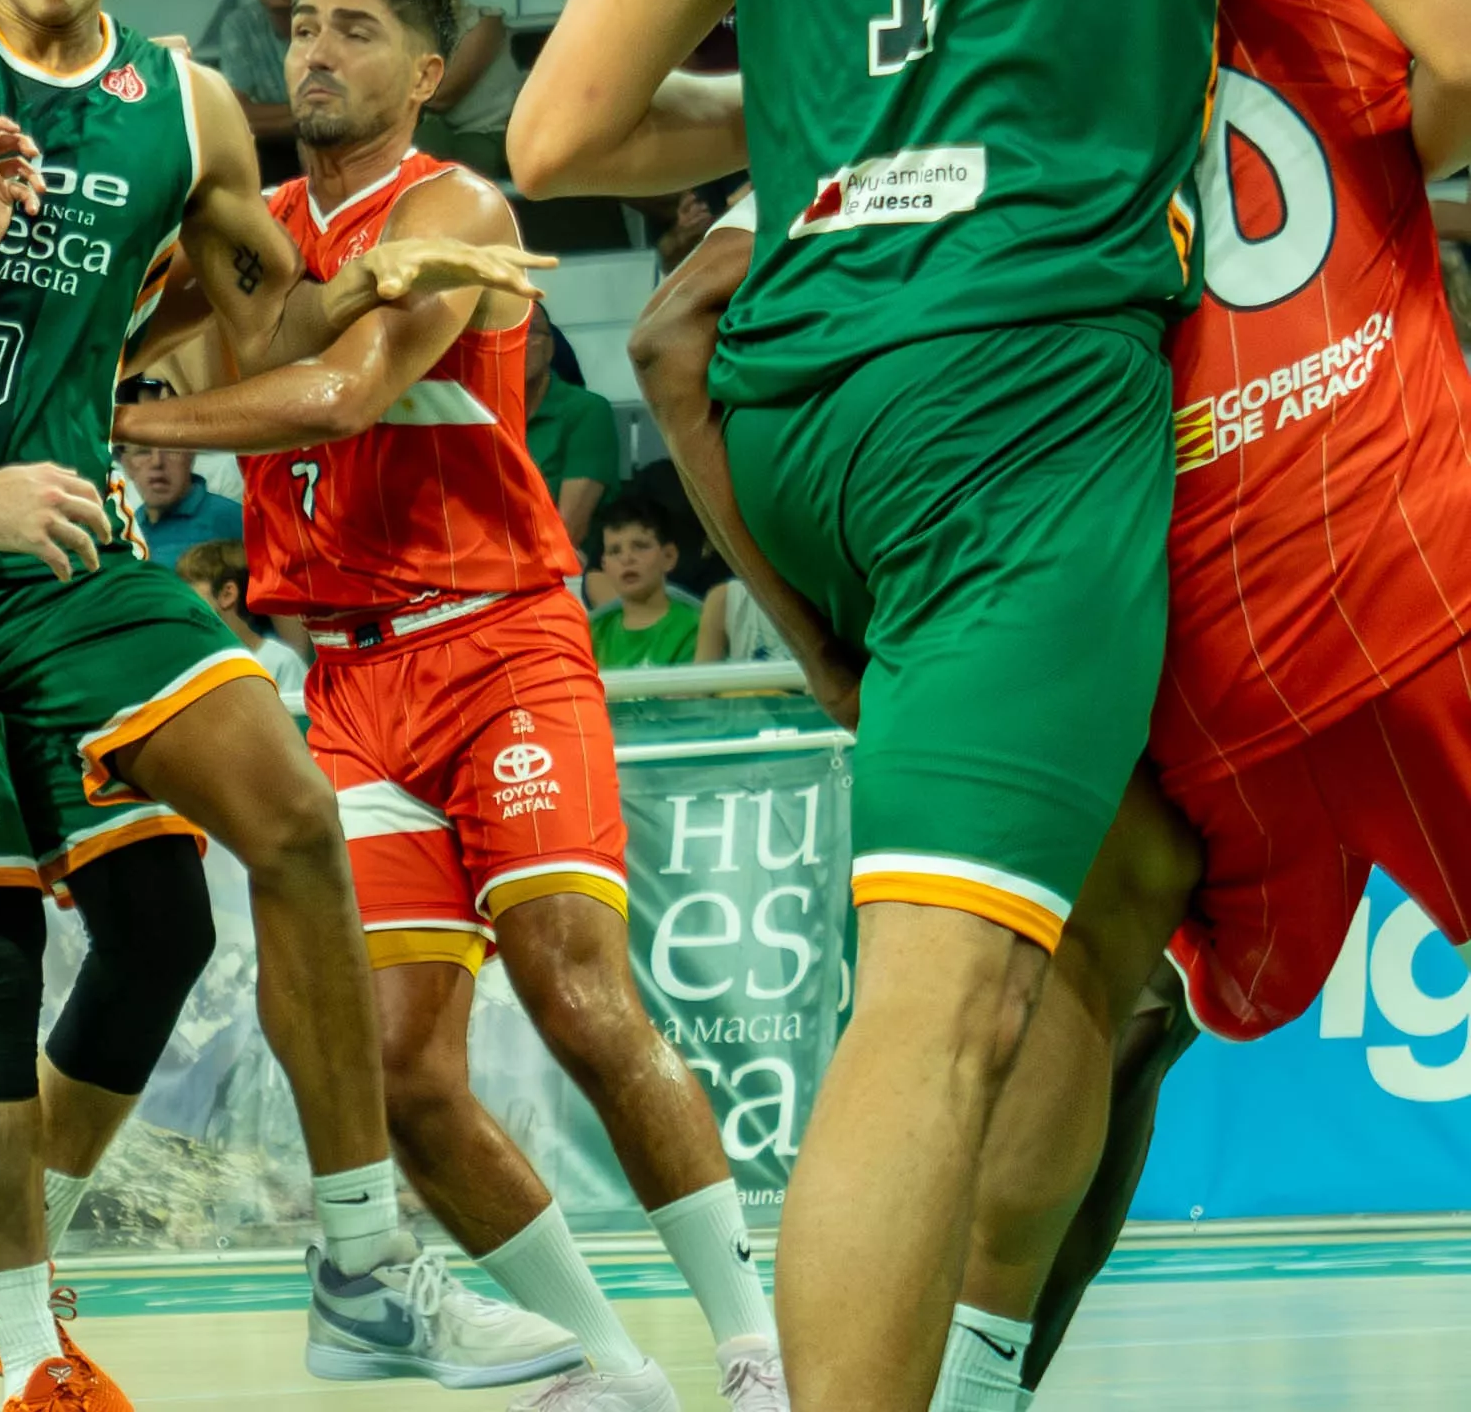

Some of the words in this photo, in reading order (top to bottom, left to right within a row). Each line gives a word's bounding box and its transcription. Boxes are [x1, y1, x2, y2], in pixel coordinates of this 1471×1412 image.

[1217, 311, 1384, 421] GOBIERNO
[1218, 411, 1264, 456] DE
[290, 460, 319, 521] 7
[493, 780, 561, 805] TOYOTA
[502, 796, 557, 820] ARTAL
[659, 784, 821, 875] Hu
[650, 884, 815, 1002] es
